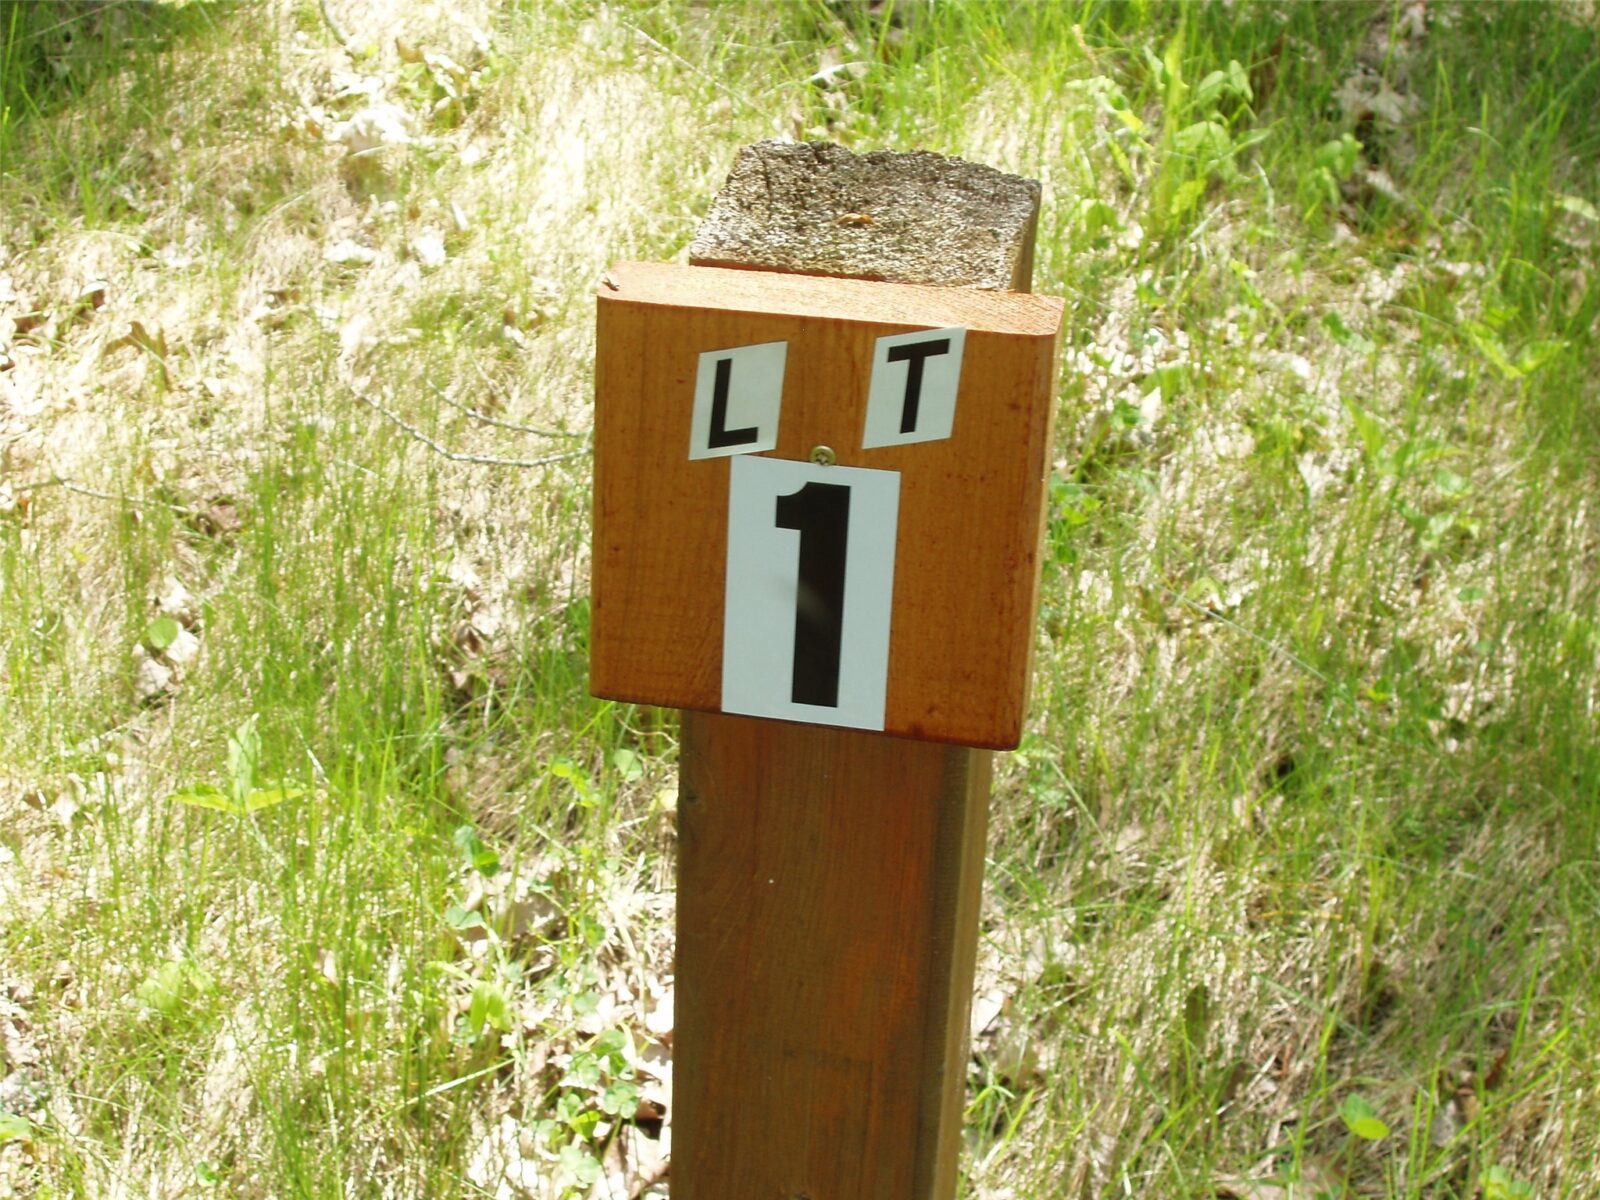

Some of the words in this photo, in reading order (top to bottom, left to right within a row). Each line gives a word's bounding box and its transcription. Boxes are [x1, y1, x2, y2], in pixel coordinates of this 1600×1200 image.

[708, 358, 759, 449] L
[887, 338, 951, 434] T
[775, 481, 851, 708] 1
